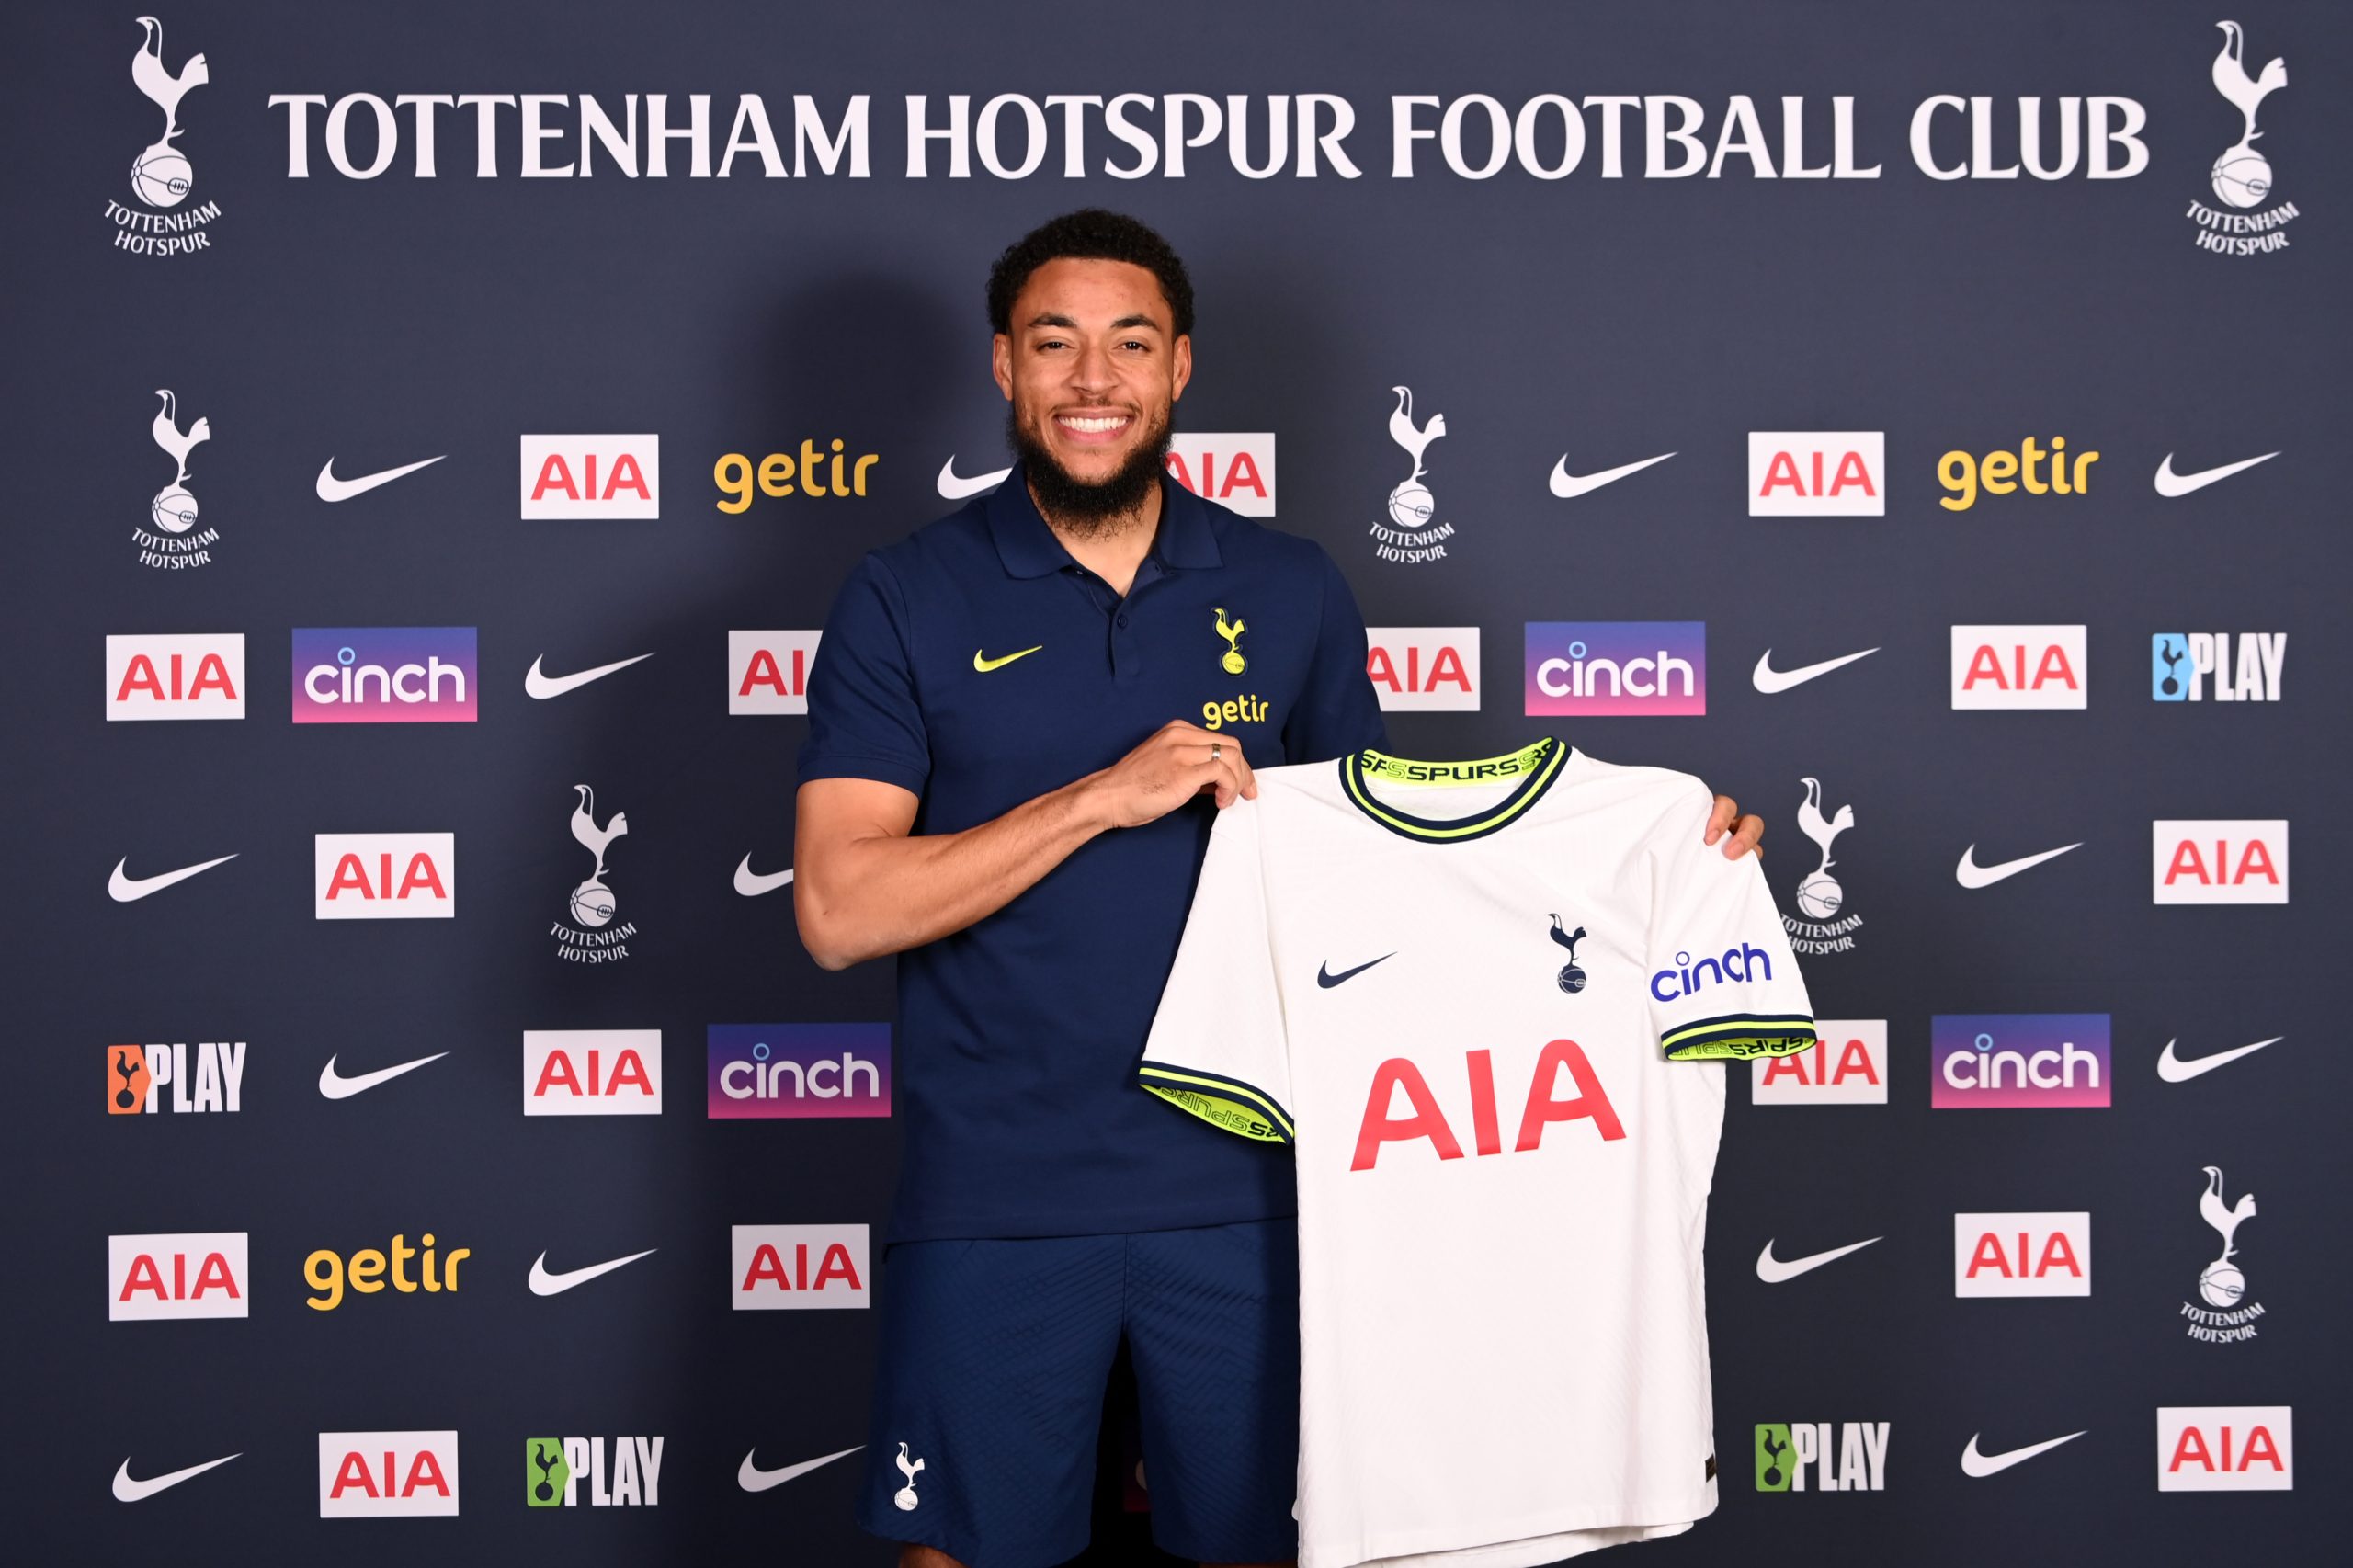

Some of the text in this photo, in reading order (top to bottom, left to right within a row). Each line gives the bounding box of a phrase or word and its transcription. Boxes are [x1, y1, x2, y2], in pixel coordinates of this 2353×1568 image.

[268, 92, 2150, 181] TOTTENHAM HOTSPUR FOOTBALL CLUB
[104, 199, 222, 233] TOTTENHAM
[2186, 199, 2300, 233] TOTTENHAM
[114, 229, 211, 256] HOTSPUR
[2195, 230, 2290, 256] HOTSPUR
[530, 453, 651, 501] AIA
[714, 438, 880, 515] getir
[1759, 450, 1876, 497] AIA
[1938, 436, 2100, 512] getir
[131, 527, 220, 552] TOTTENHAM
[1369, 521, 1456, 547] TOTTENHAM
[1376, 544, 1448, 564] HOTSPUR
[139, 549, 211, 570] HOTSPUR
[117, 653, 237, 702] AIA
[304, 646, 466, 705] cinch
[738, 648, 805, 697] AI
[1366, 646, 1472, 693] AIA
[1536, 641, 1695, 699] cinch
[1961, 643, 2078, 691] AIA
[2188, 632, 2288, 702] PLAY
[1202, 694, 1269, 731] getir
[1406, 758, 1519, 781] SPURS
[325, 851, 447, 901] AIA
[2164, 838, 2280, 886] AIA
[551, 922, 637, 947] TOTTENHAM
[1781, 913, 1864, 937] TOTTENHAM
[1789, 936, 1856, 954] HOTSPUR
[557, 944, 629, 963] HOTSPUR
[1651, 942, 1772, 1002] cinch
[144, 1041, 247, 1114] PLAY
[533, 1048, 654, 1097] AIA
[720, 1043, 880, 1099] cinch
[1762, 1039, 1880, 1086] AIA
[1942, 1033, 2100, 1090] cinch
[1350, 1039, 1627, 1172] AIA
[119, 1251, 241, 1302] AIA
[303, 1233, 472, 1312] getir
[742, 1242, 863, 1292] AIA
[1965, 1231, 2083, 1279] AIA
[2180, 1301, 2266, 1326] TOTTENHAM
[2188, 1324, 2258, 1344] HOTSPUR
[563, 1436, 665, 1507] PLAY
[1790, 1422, 1891, 1492] PLAY
[2168, 1425, 2285, 1473] AIA
[330, 1449, 451, 1500] AIA
